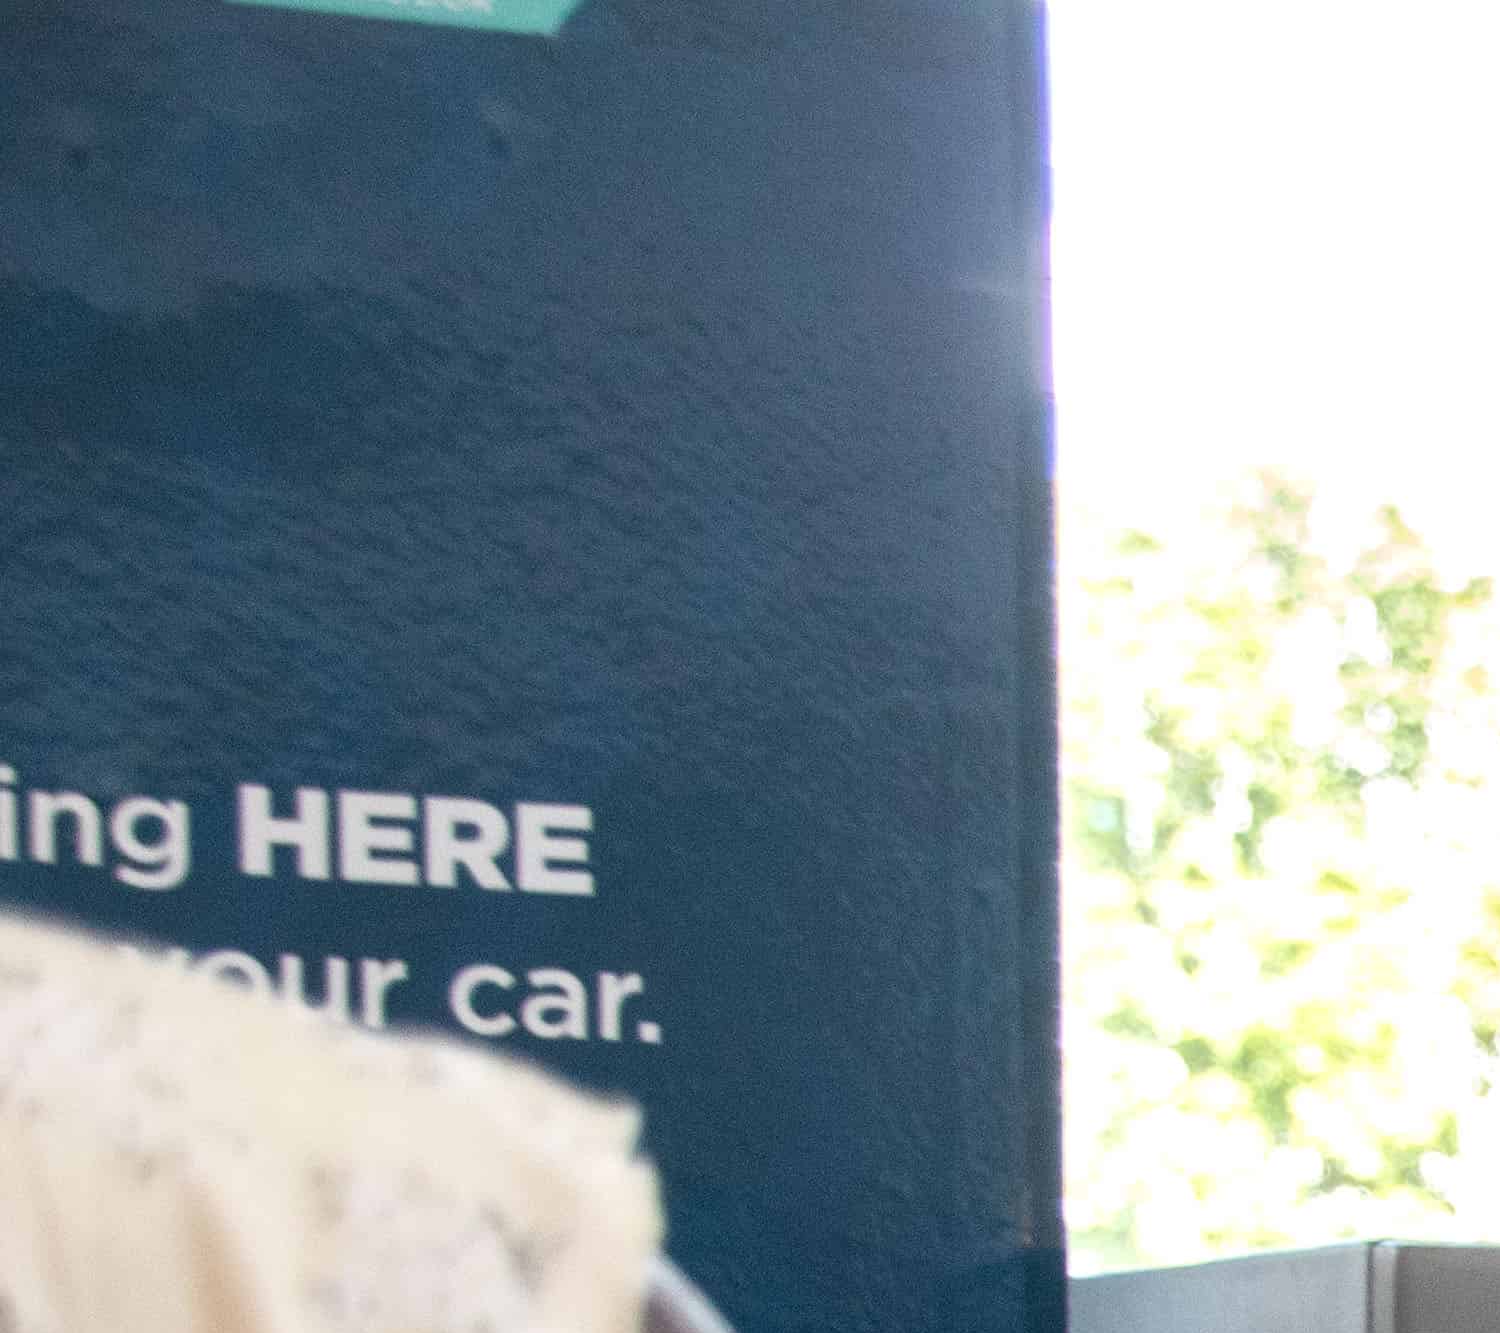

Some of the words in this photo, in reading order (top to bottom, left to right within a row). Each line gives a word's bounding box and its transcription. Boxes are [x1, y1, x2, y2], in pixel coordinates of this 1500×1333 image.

[0, 760, 190, 890] ing
[238, 783, 594, 896] HERE
[118, 944, 408, 1030] our
[448, 962, 661, 1043] car.
